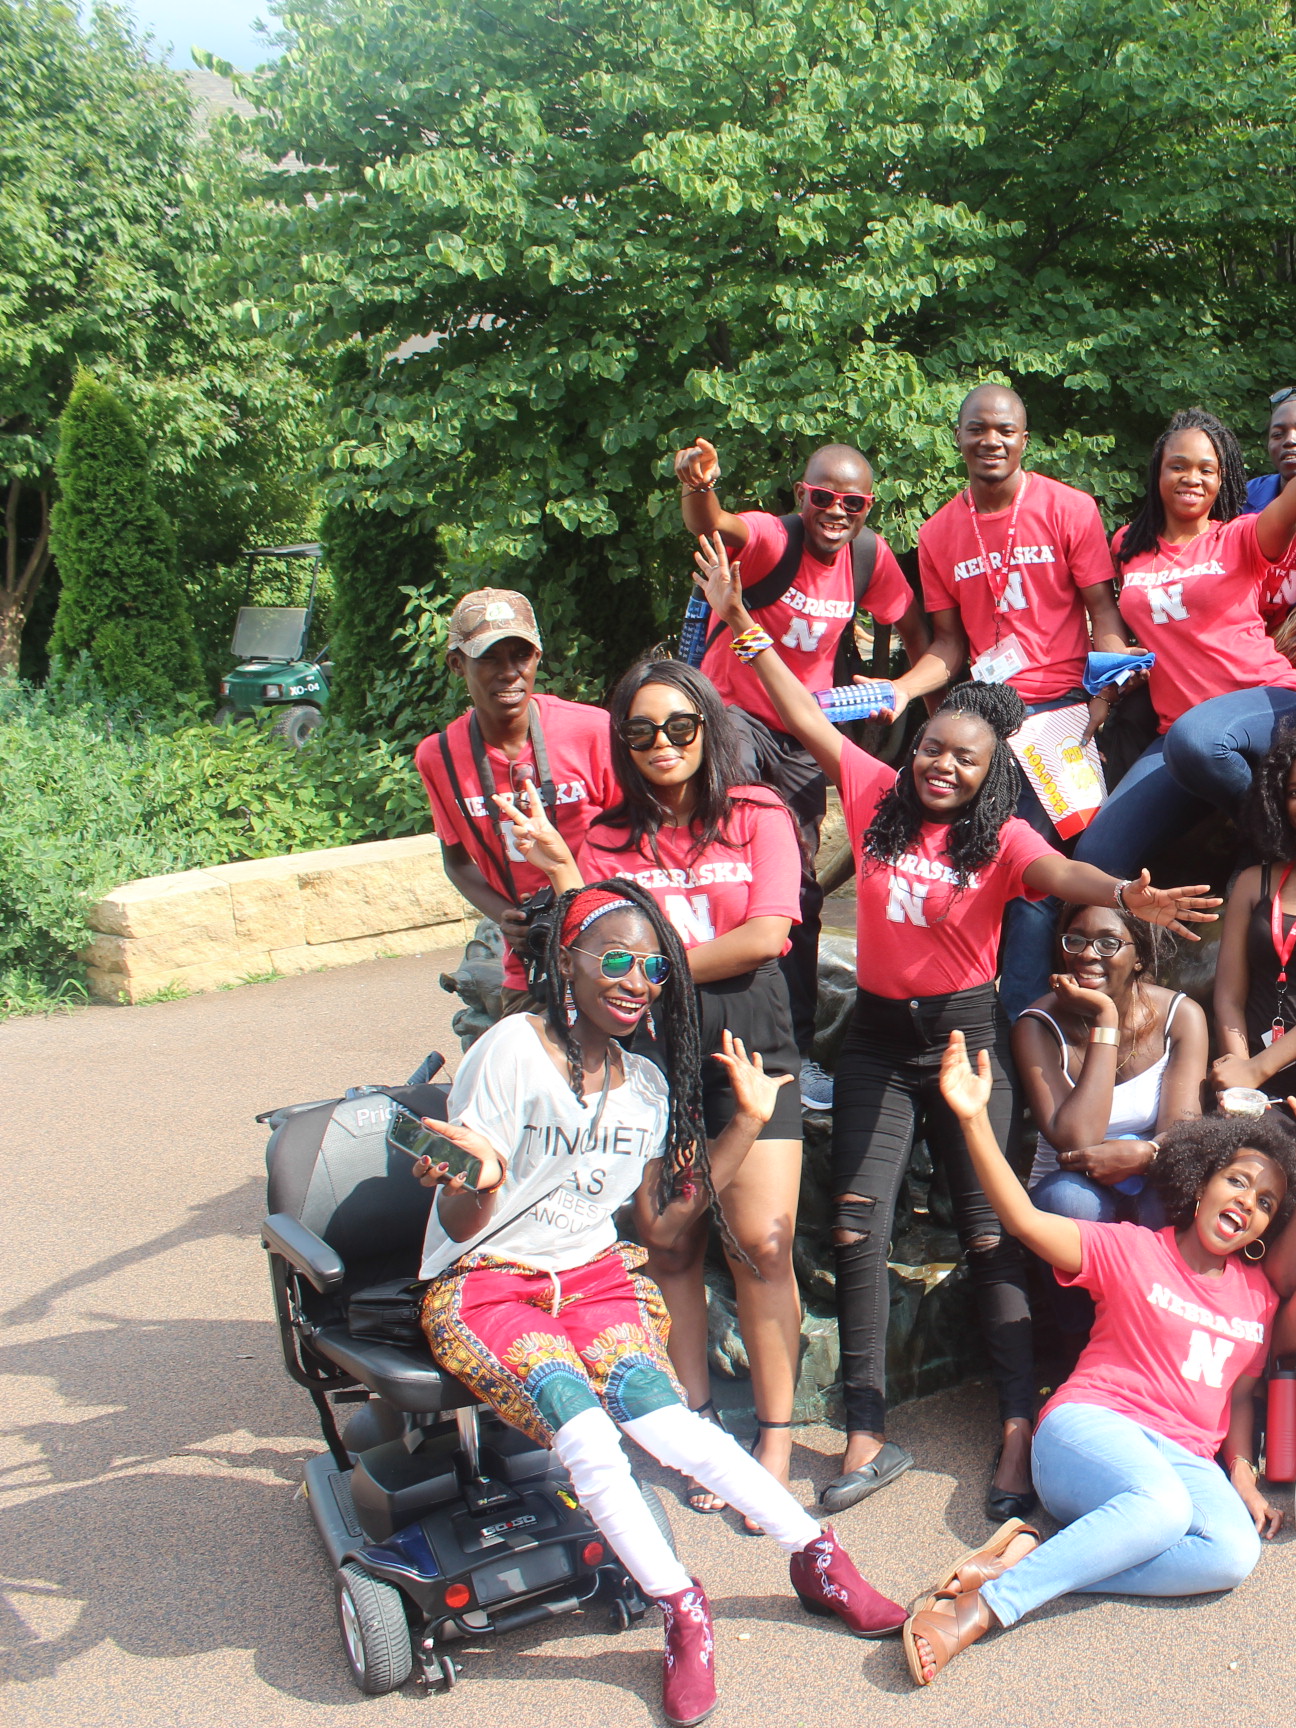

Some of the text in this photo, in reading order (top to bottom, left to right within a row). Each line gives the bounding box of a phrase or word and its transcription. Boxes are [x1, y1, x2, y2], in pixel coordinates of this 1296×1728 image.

[954, 545, 1055, 582] NERSKA
[780, 586, 856, 618] EBRASK
[1147, 583, 1190, 624] N
[781, 616, 828, 652] N
[290, 682, 320, 697] XO-04
[1022, 743, 1069, 816] POPCORN
[664, 893, 716, 944] N
[886, 875, 931, 928] N
[1181, 1329, 1236, 1388] N
